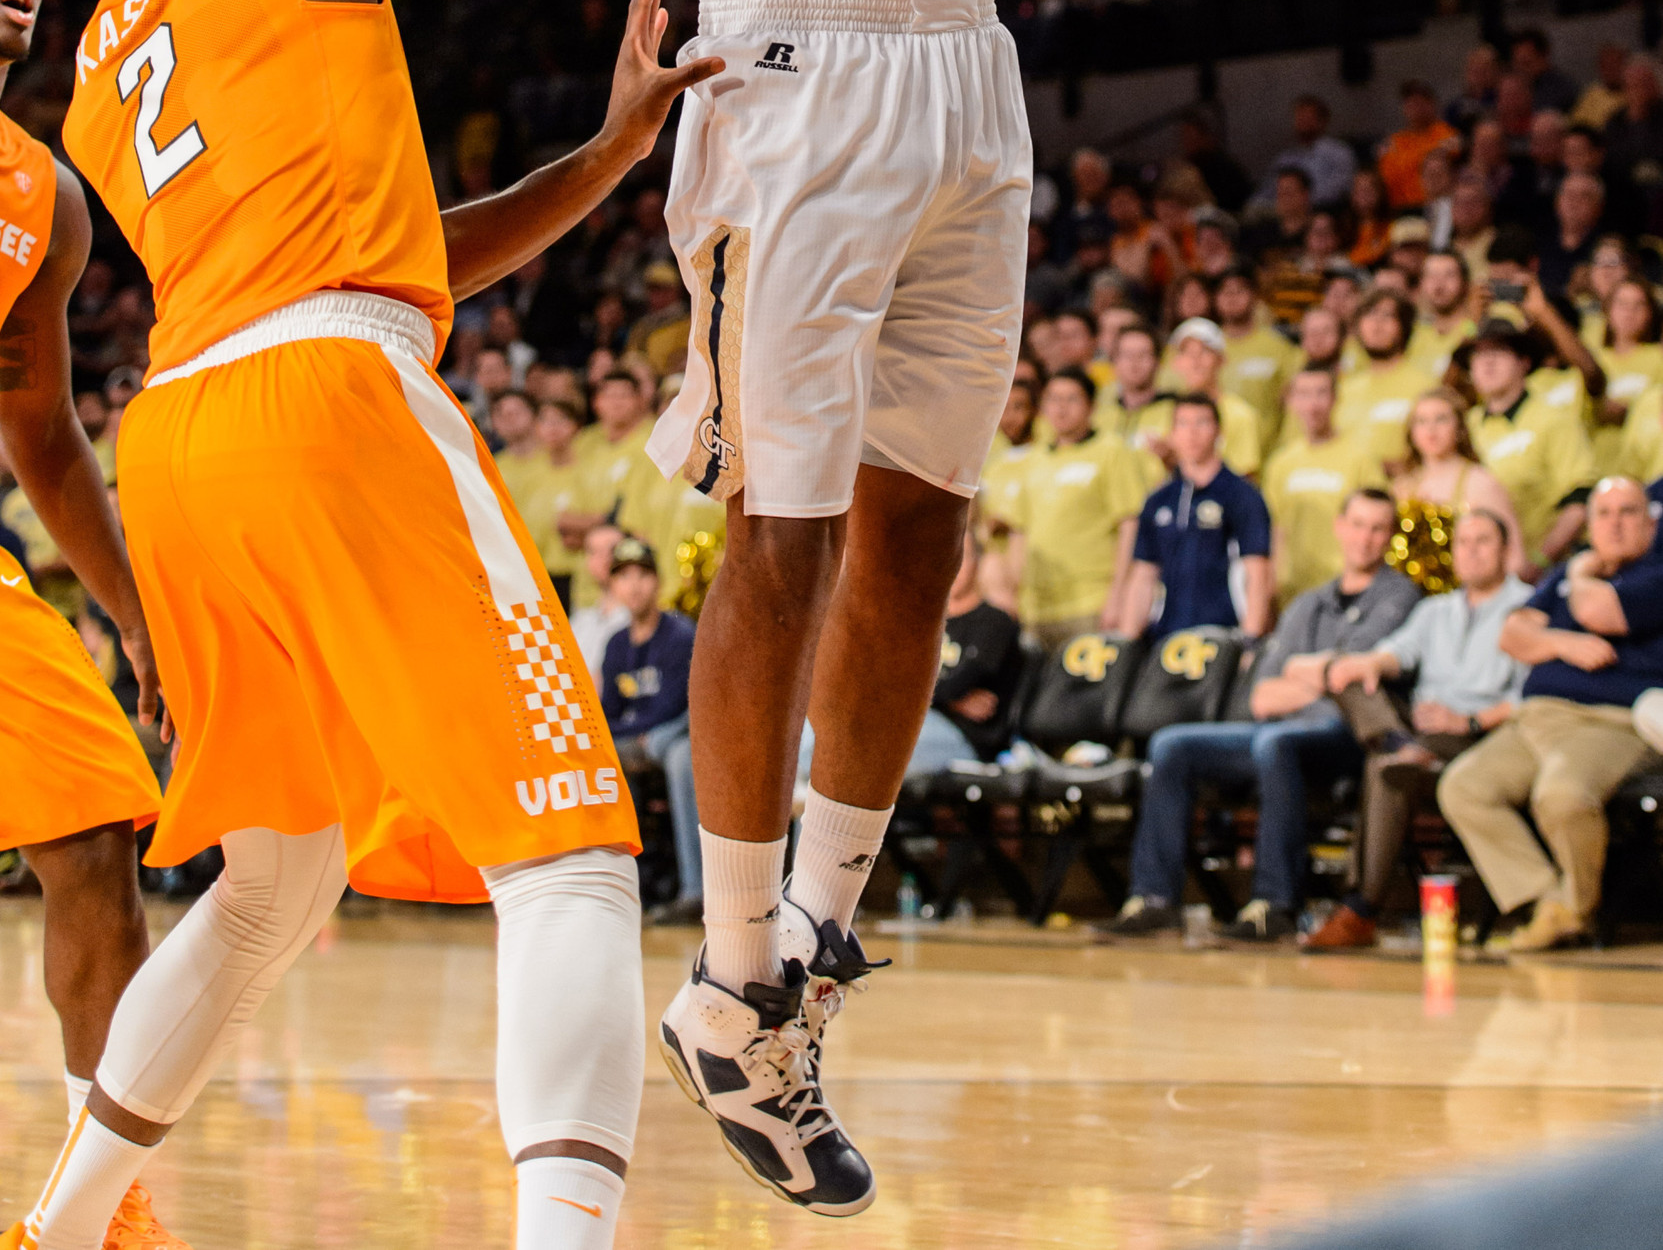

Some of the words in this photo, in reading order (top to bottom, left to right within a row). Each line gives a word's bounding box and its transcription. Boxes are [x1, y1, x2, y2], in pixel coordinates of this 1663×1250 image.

[754, 61, 799, 73] RUSSELL
[116, 22, 208, 200] 2
[0, 218, 38, 267] EE
[699, 416, 736, 470] GT
[515, 767, 618, 816] VOLS
